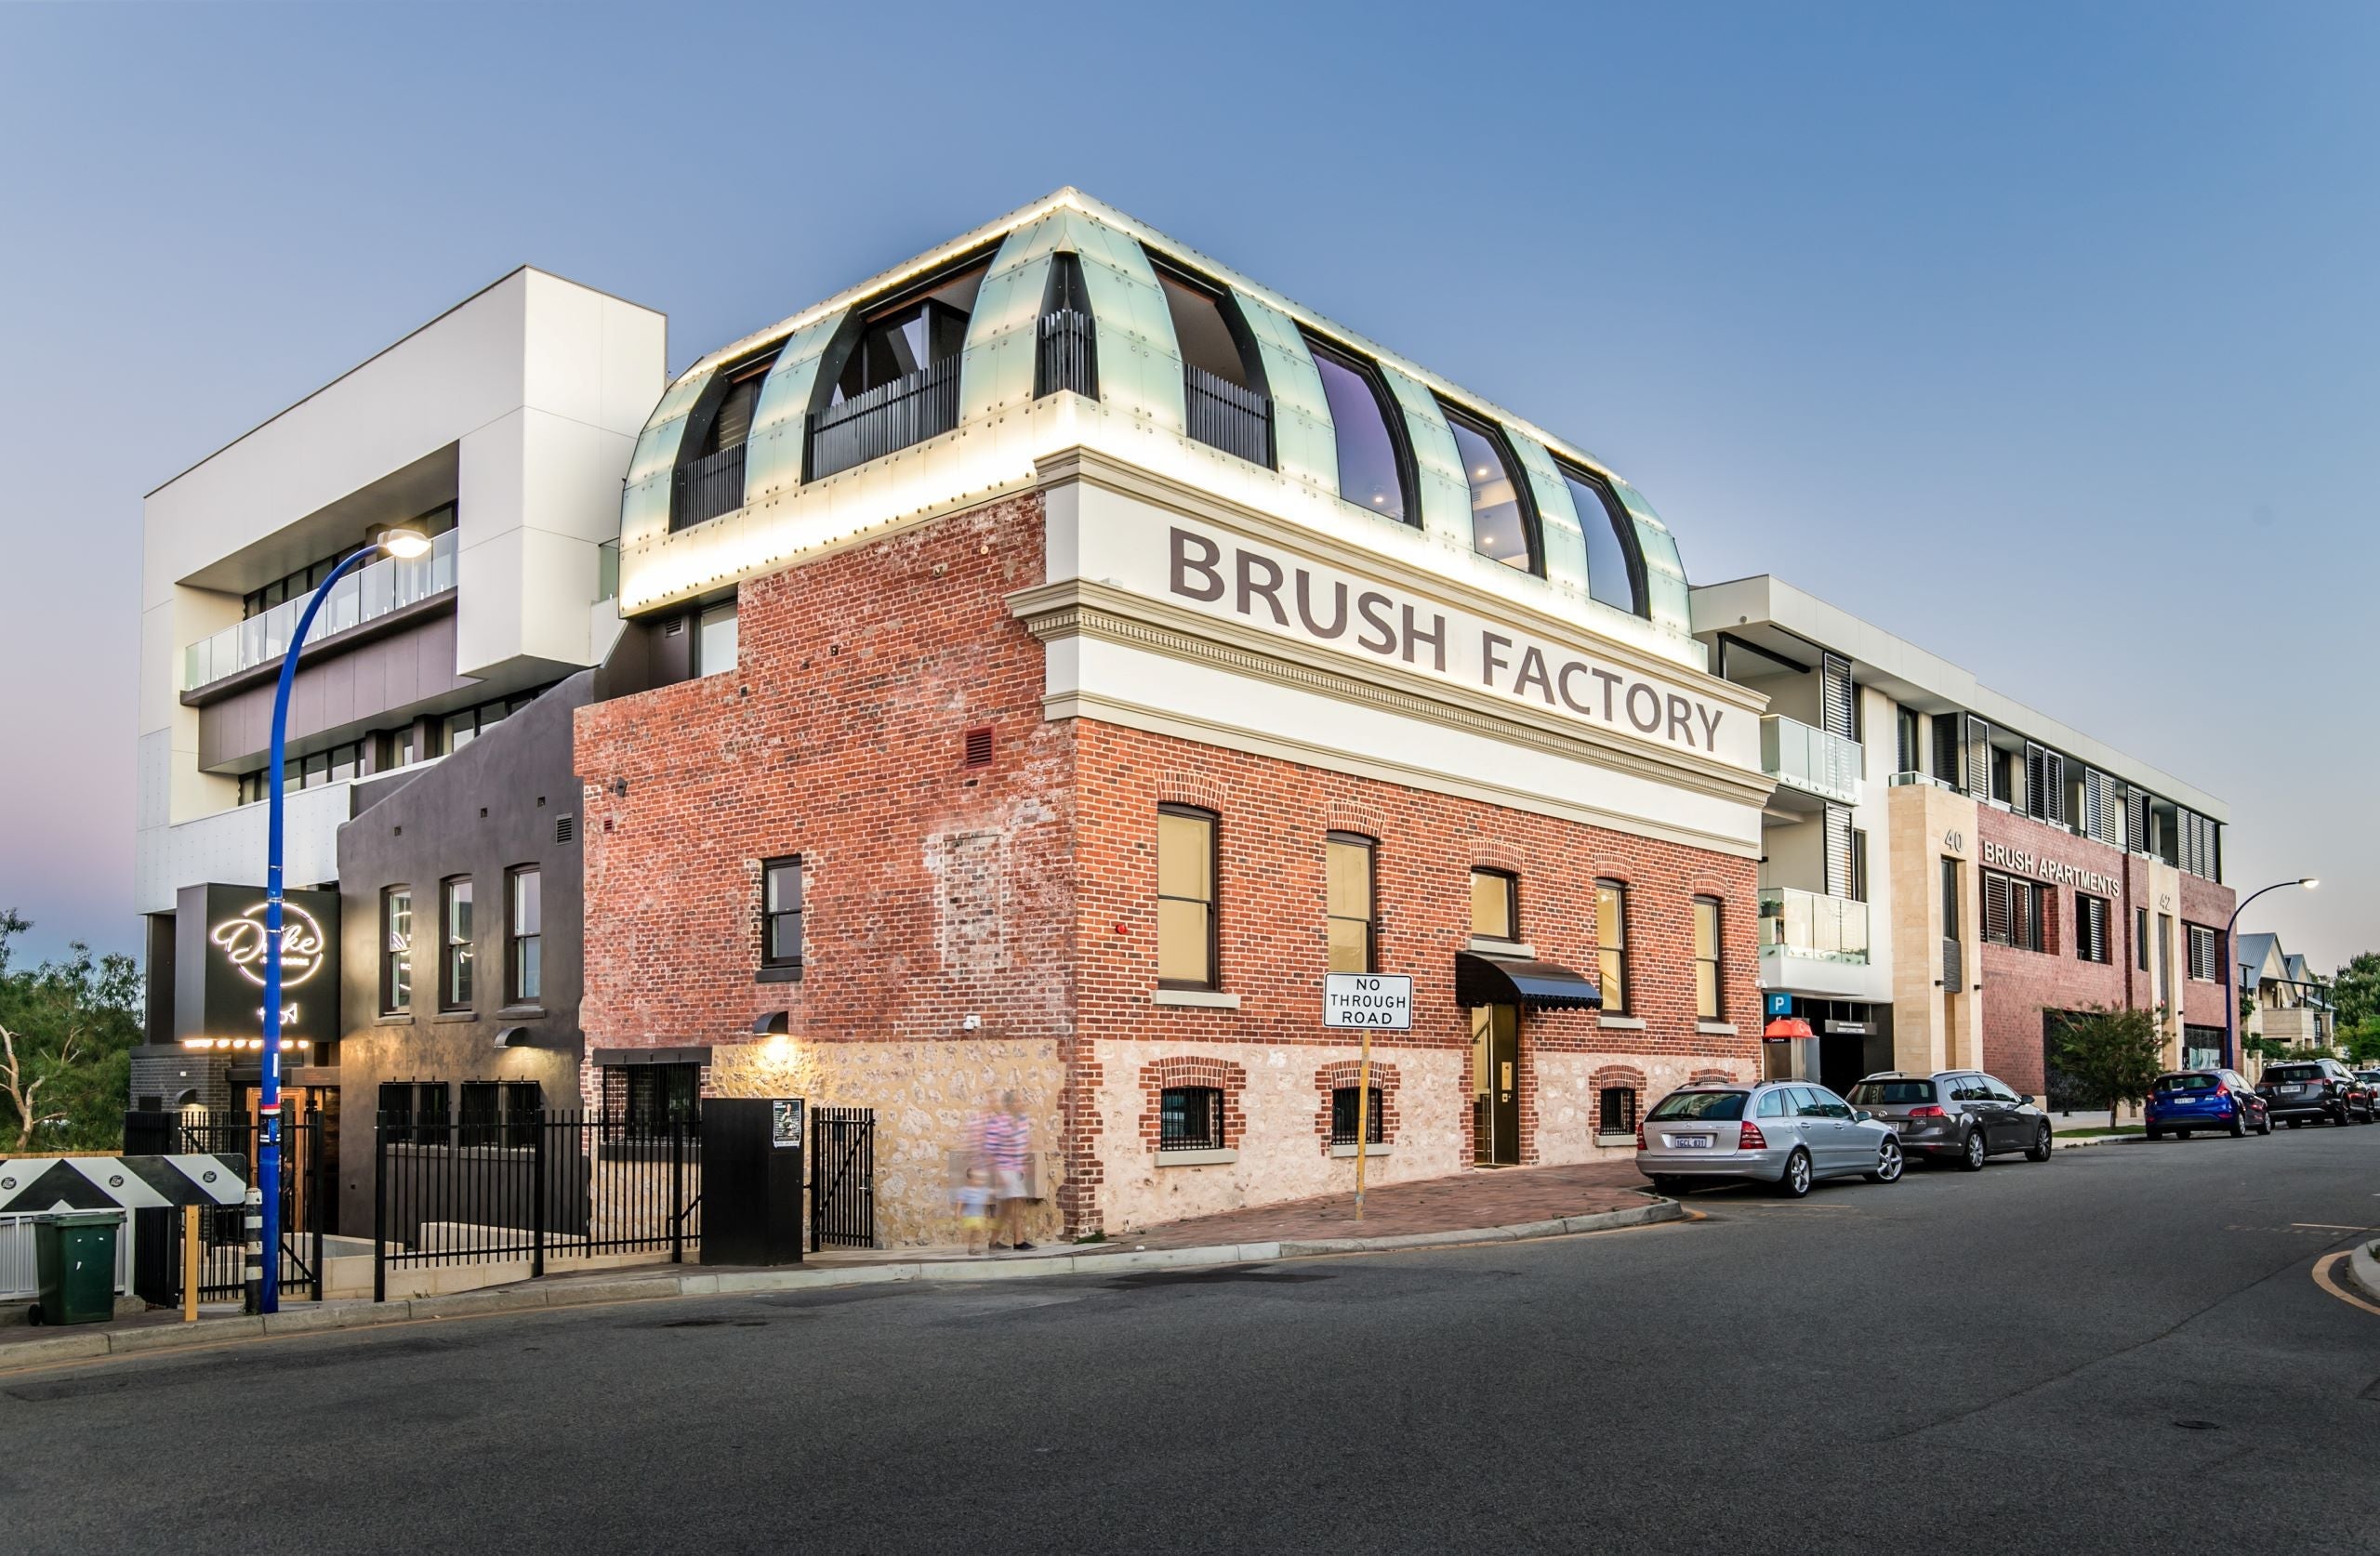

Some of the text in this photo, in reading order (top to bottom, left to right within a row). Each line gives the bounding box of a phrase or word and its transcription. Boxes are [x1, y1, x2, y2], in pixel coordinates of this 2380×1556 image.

[1169, 525, 1724, 752] BRUSH FACTORY
[1944, 829, 1964, 852] 40
[1984, 840, 2121, 897] BRUSH APARTMENTS
[2159, 893, 2171, 911] 42
[210, 918, 323, 964] Dke
[1356, 979, 1381, 991] NO
[1330, 994, 1406, 1009] THROUGH
[1775, 996, 1785, 1011] P
[1342, 1010, 1393, 1024] ROAD
